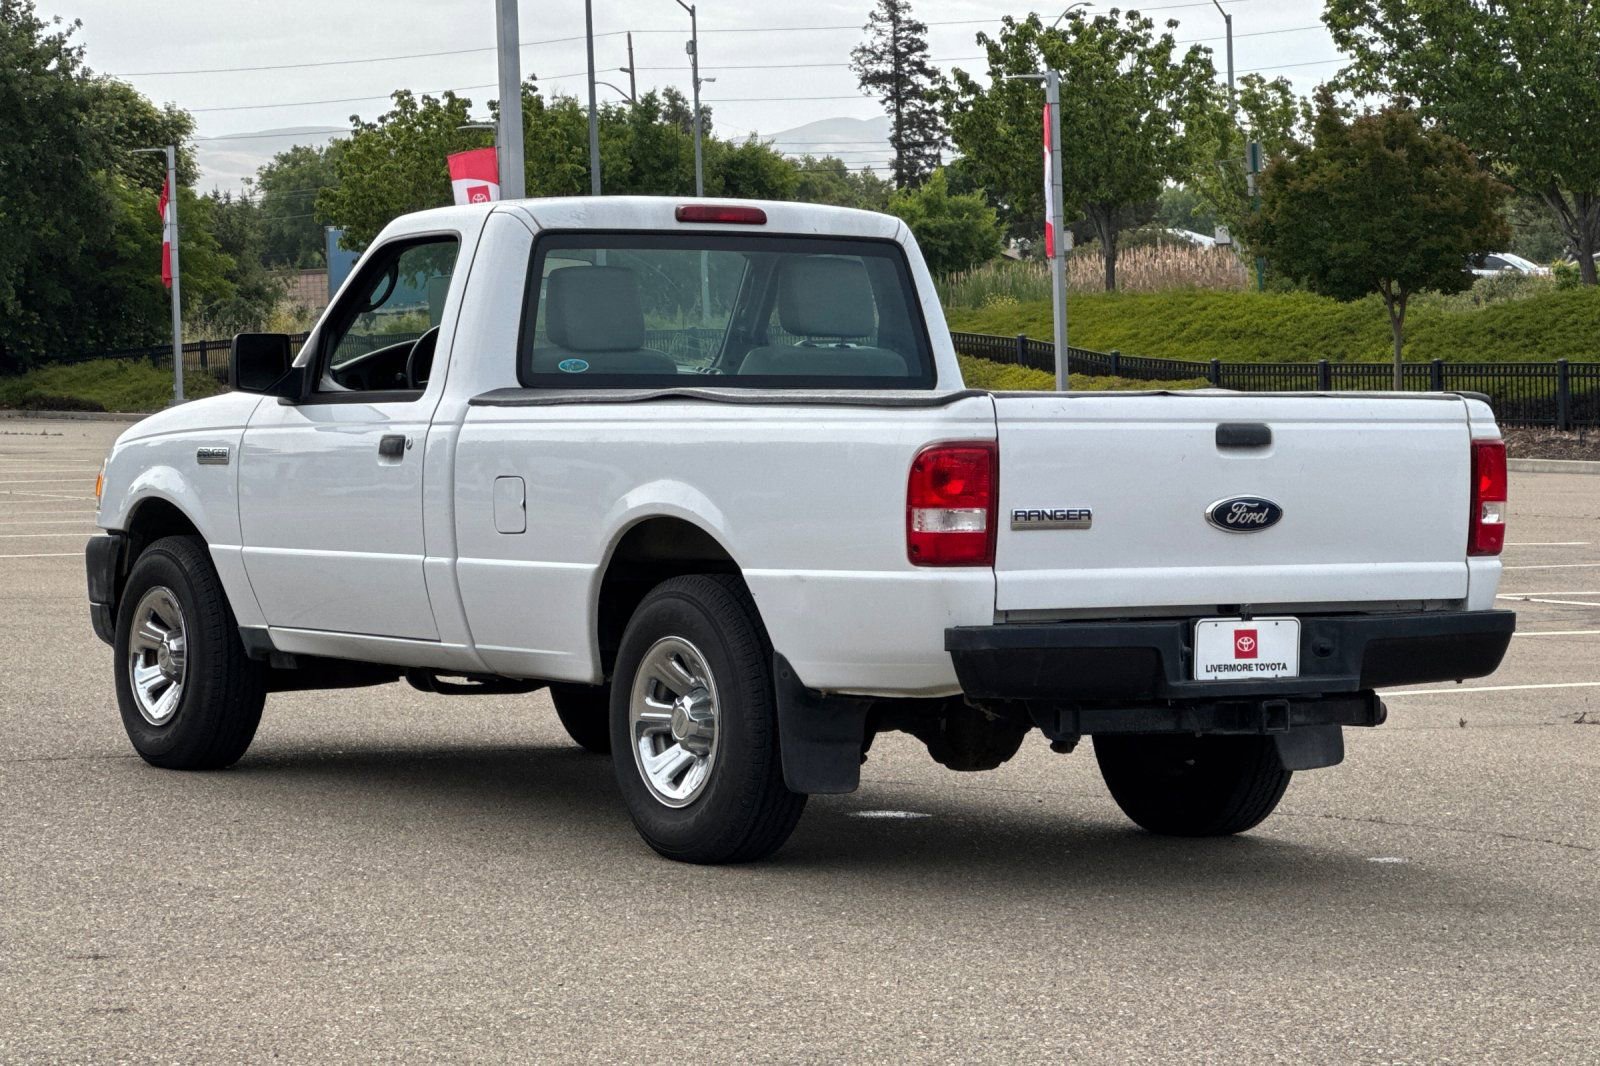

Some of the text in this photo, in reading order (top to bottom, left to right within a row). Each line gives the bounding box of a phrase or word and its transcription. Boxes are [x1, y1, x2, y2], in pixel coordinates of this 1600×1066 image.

[1014, 509, 1092, 521] RANGER
[1226, 502, 1269, 524] Ford
[1205, 662, 1288, 673] LIVERMORE TOYOTA
